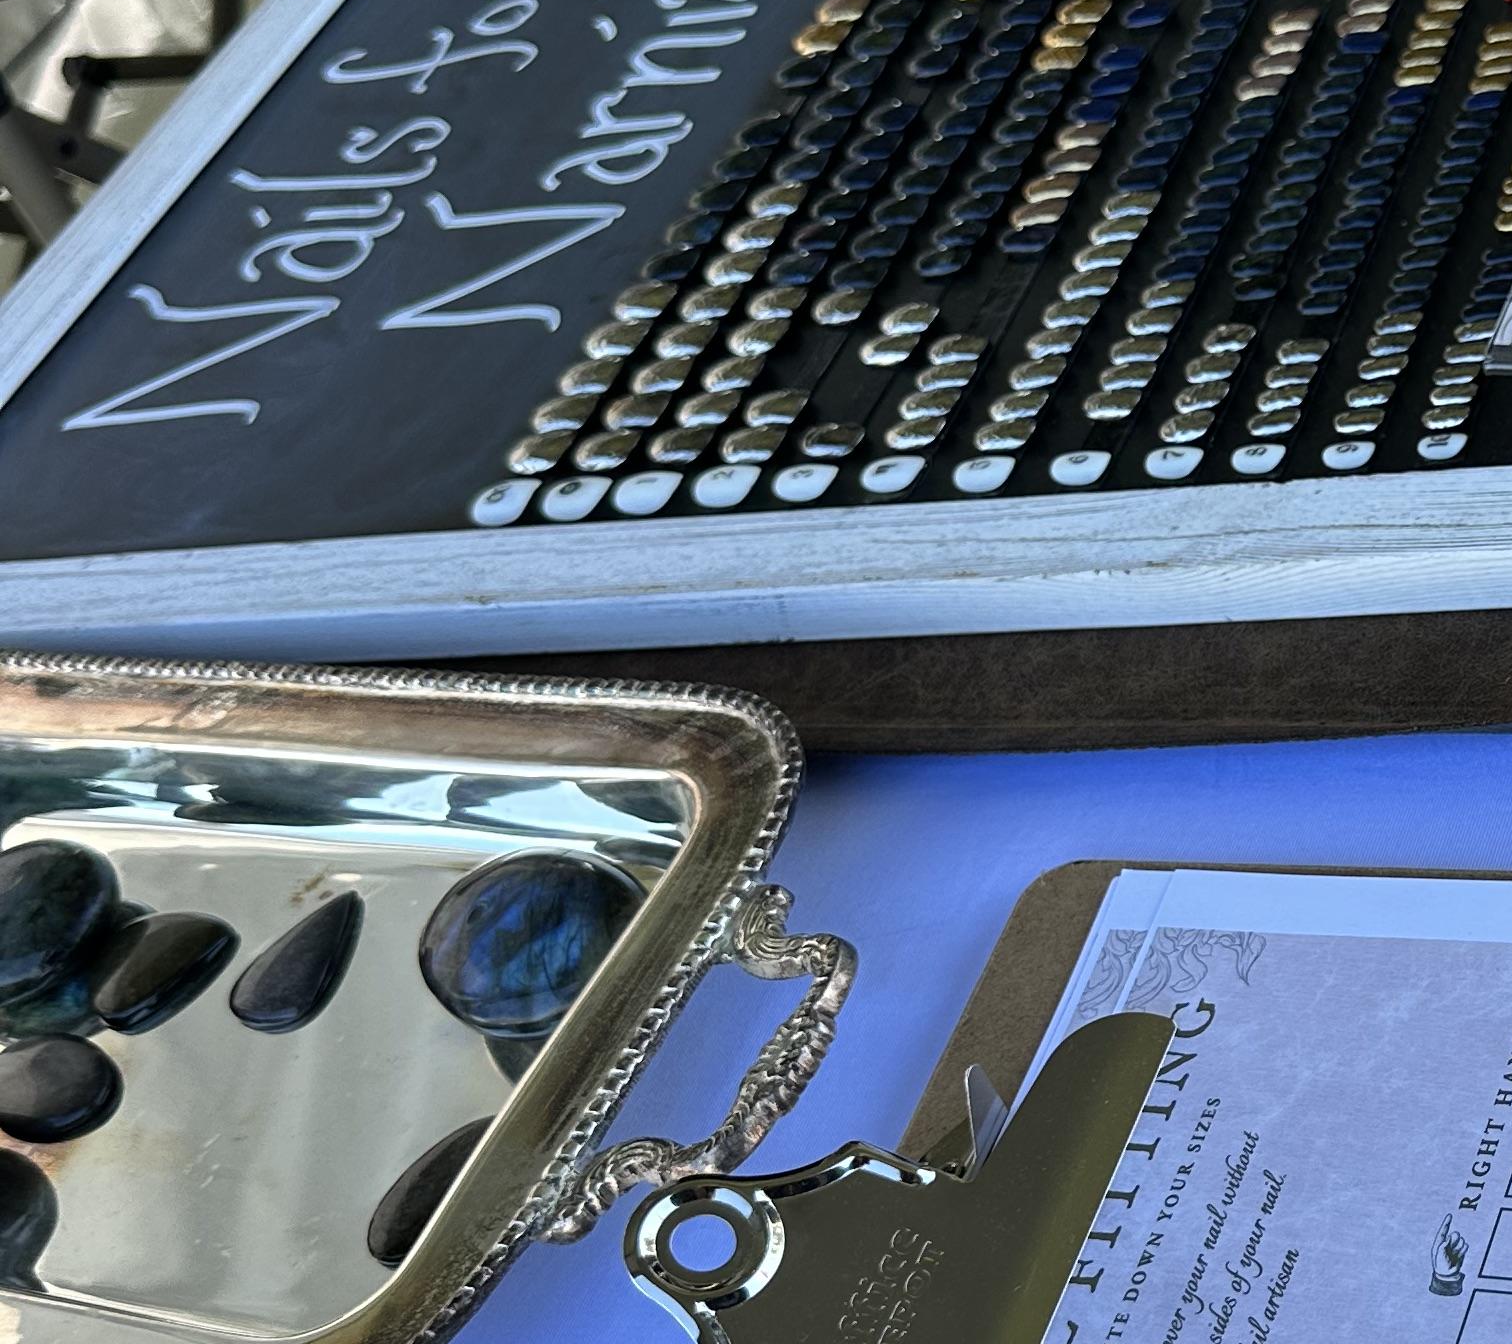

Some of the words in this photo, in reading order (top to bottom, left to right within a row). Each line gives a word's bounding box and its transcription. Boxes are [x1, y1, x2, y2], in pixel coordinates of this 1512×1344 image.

[60, 117, 450, 430] Nails
[1121, 1232, 1164, 1303] DOWN
[1156, 1162, 1195, 1222] YOUR
[1187, 1098, 1221, 1153] SIZES
[1181, 1253, 1208, 1315] your
[1204, 1203, 1227, 1250] nail
[1221, 1130, 1259, 1207] without
[1458, 1118, 1505, 1212] RIGHT
[1208, 1296, 1237, 1344] sides
[1226, 1262, 1250, 1295] of
[1240, 1218, 1266, 1278] your
[1261, 1169, 1287, 1215] nail.
[1264, 1249, 1299, 1322] artisan
